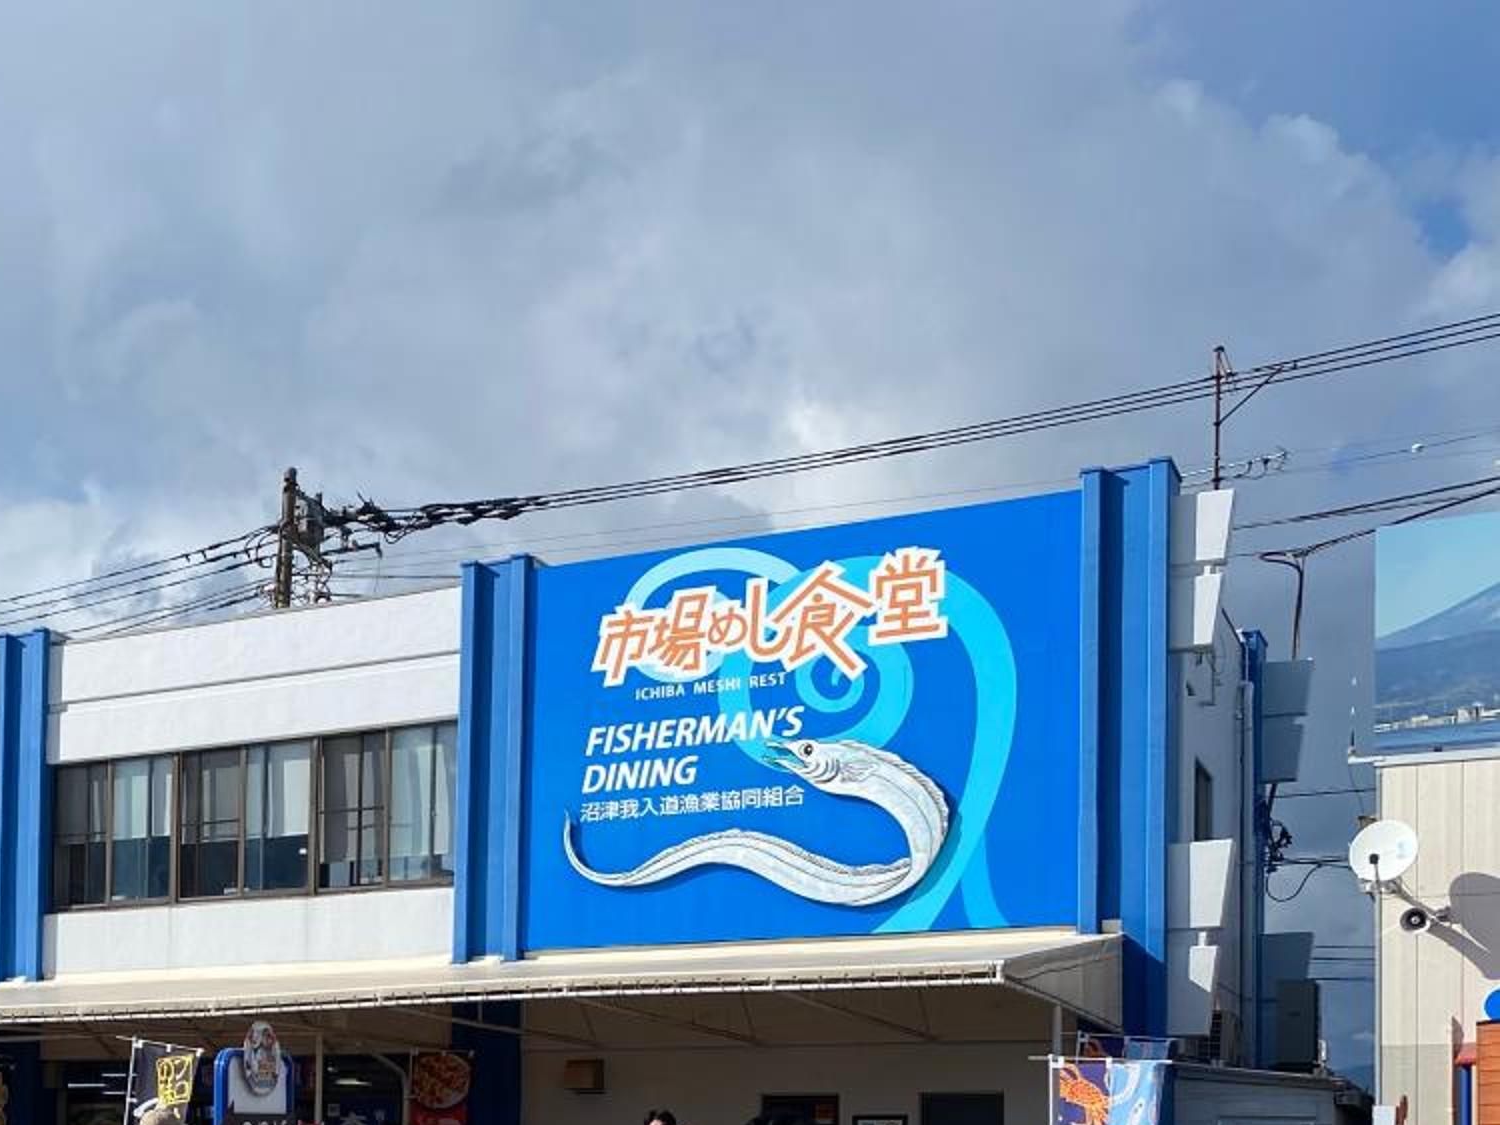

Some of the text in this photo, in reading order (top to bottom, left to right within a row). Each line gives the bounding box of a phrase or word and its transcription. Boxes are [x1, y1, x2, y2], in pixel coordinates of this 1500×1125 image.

[594, 549, 945, 686] 市場めし食堂
[635, 671, 787, 700] ICHIBA MESHI REST
[585, 706, 804, 756] FISHERMAN'S
[582, 755, 698, 794] DINING
[580, 785, 805, 823] 沼津我入道漁業協同組合
